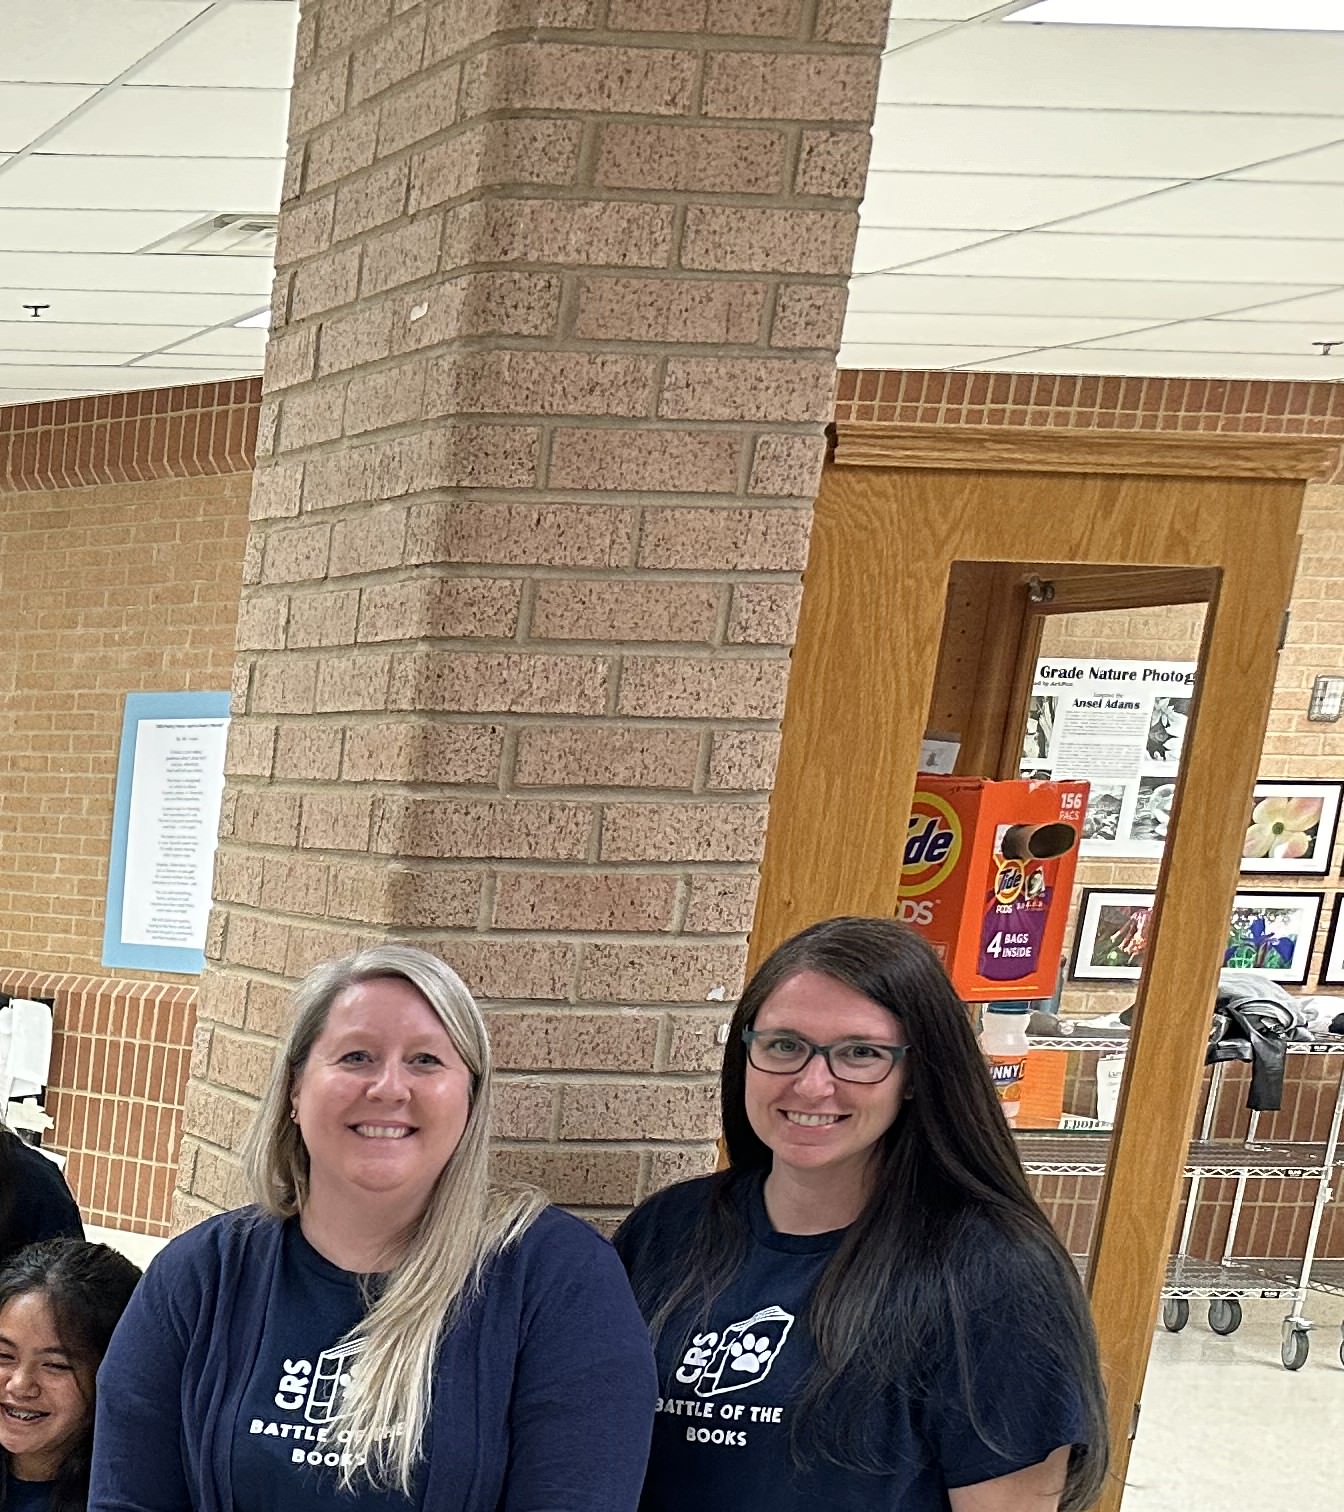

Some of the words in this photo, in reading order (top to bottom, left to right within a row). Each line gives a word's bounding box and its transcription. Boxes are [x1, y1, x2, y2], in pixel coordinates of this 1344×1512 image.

[1040, 665, 1084, 679] Grade
[1088, 667, 1137, 681] Nature
[1073, 699, 1102, 708] Ansel
[1105, 700, 1140, 709] Adams
[1061, 793, 1082, 809] 156
[903, 817, 954, 865] de
[997, 869, 1022, 895] Tide
[987, 932, 1002, 958] 4
[1004, 934, 1029, 944] BAGS
[1002, 947, 1032, 957] INSIDE
[675, 1332, 718, 1384] CRS
[275, 1358, 312, 1410] CRS
[720, 1404, 745, 1421] OF
[750, 1406, 783, 1423] THE
[249, 1419, 328, 1442] BATTLE
[686, 1427, 747, 1447] BOOKS
